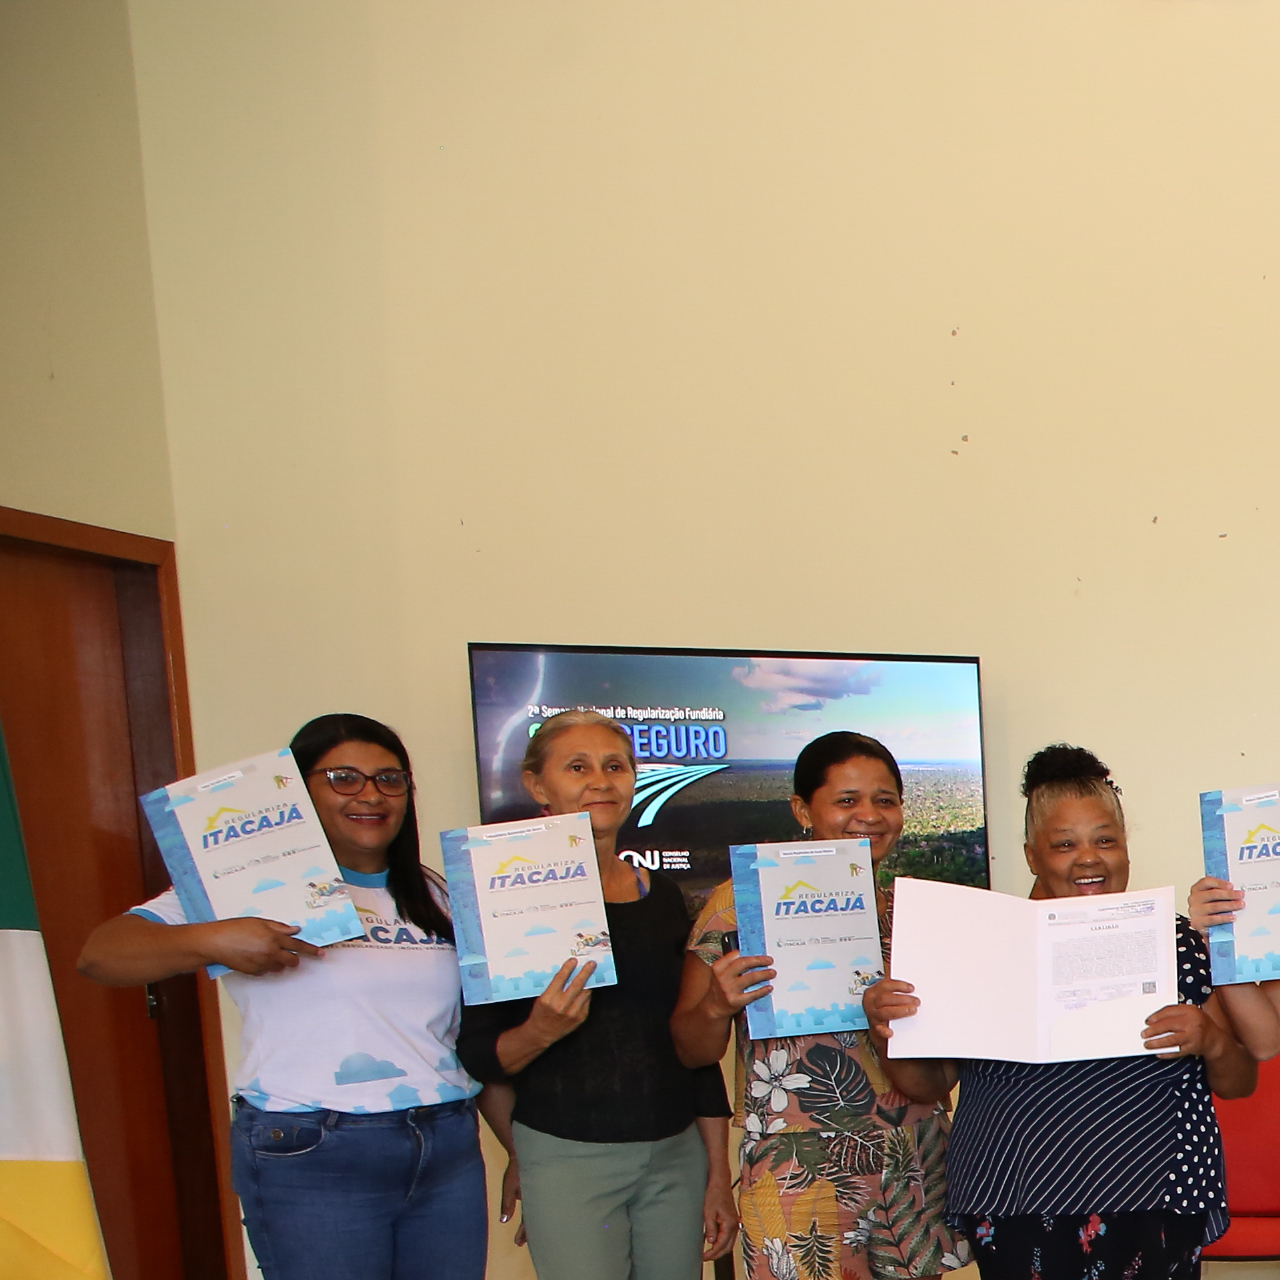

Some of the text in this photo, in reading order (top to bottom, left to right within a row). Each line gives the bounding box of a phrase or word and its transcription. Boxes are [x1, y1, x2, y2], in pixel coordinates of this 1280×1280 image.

[615, 707, 626, 719] de
[627, 706, 684, 722] Regularização
[685, 707, 724, 720] Fundiária
[620, 724, 726, 758] EGURO
[202, 802, 304, 849] ITACAJÁ
[224, 802, 288, 826] REGULARIZA
[489, 862, 587, 890] ITACAJÁ
[514, 860, 576, 872] REGULARIZA
[775, 893, 865, 916] ITACAJÁ
[799, 890, 855, 899] REGULARIZA
